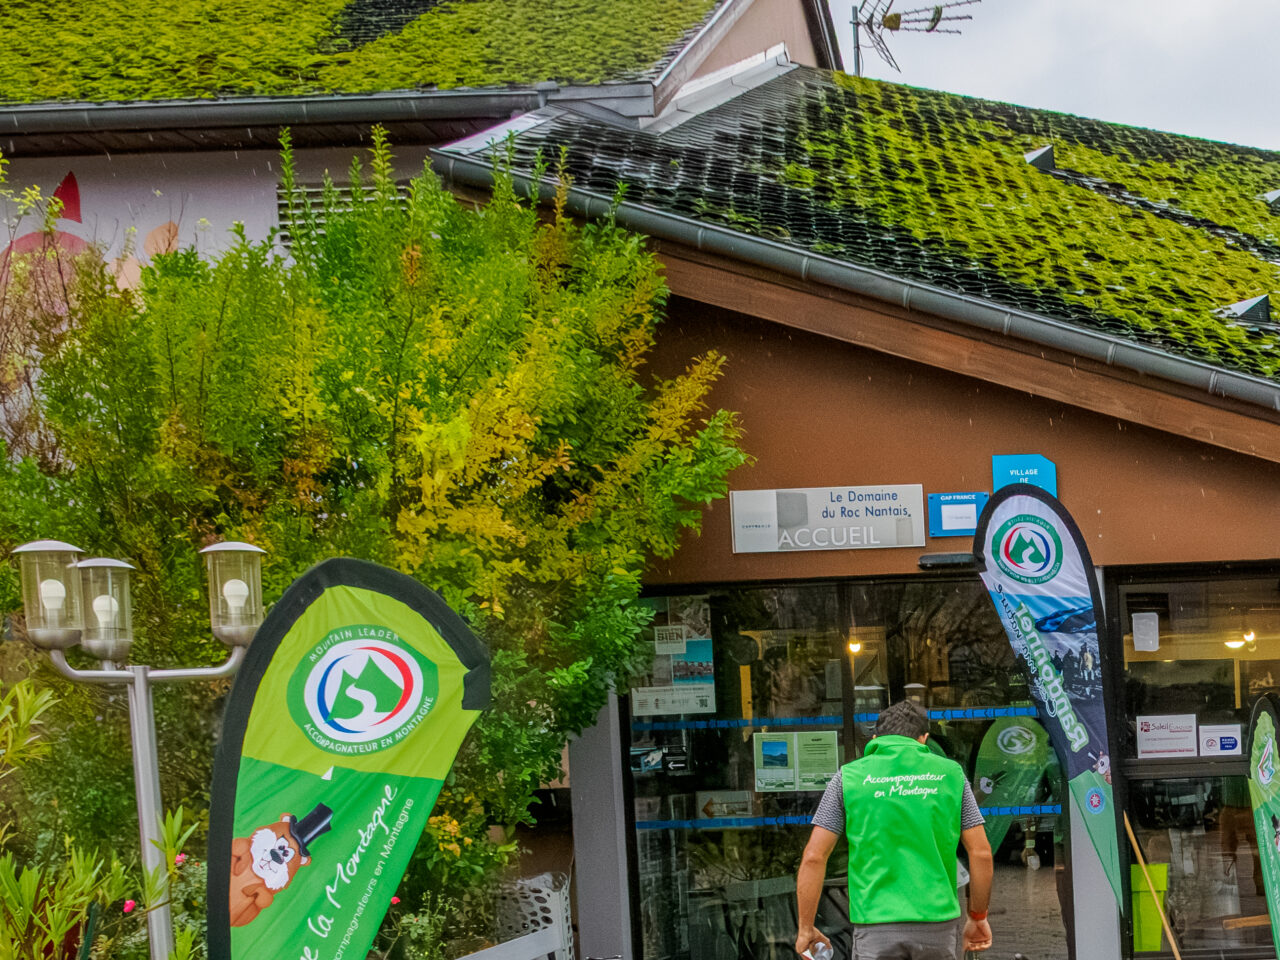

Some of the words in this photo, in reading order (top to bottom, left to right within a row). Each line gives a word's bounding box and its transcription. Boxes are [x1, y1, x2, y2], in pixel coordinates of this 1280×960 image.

[1010, 468, 1038, 476] VILLAGE
[830, 491, 843, 503] Le
[848, 490, 899, 503] Domaine
[822, 506, 838, 519] du
[840, 505, 860, 518] Roc
[778, 525, 881, 548] ACCUEIL
[358, 628, 400, 642] LEADER
[304, 723, 378, 753] ACCOMPAGNATEUR
[380, 737, 394, 748] EN
[395, 696, 434, 741] MONTAGNE
[863, 772, 947, 787] Accompagnateur
[874, 790, 885, 798] en
[889, 785, 938, 800] Montagne
[374, 861, 386, 876] en
[380, 798, 414, 859] Montagne
[308, 914, 334, 938] la
[326, 784, 398, 909] Montagne
